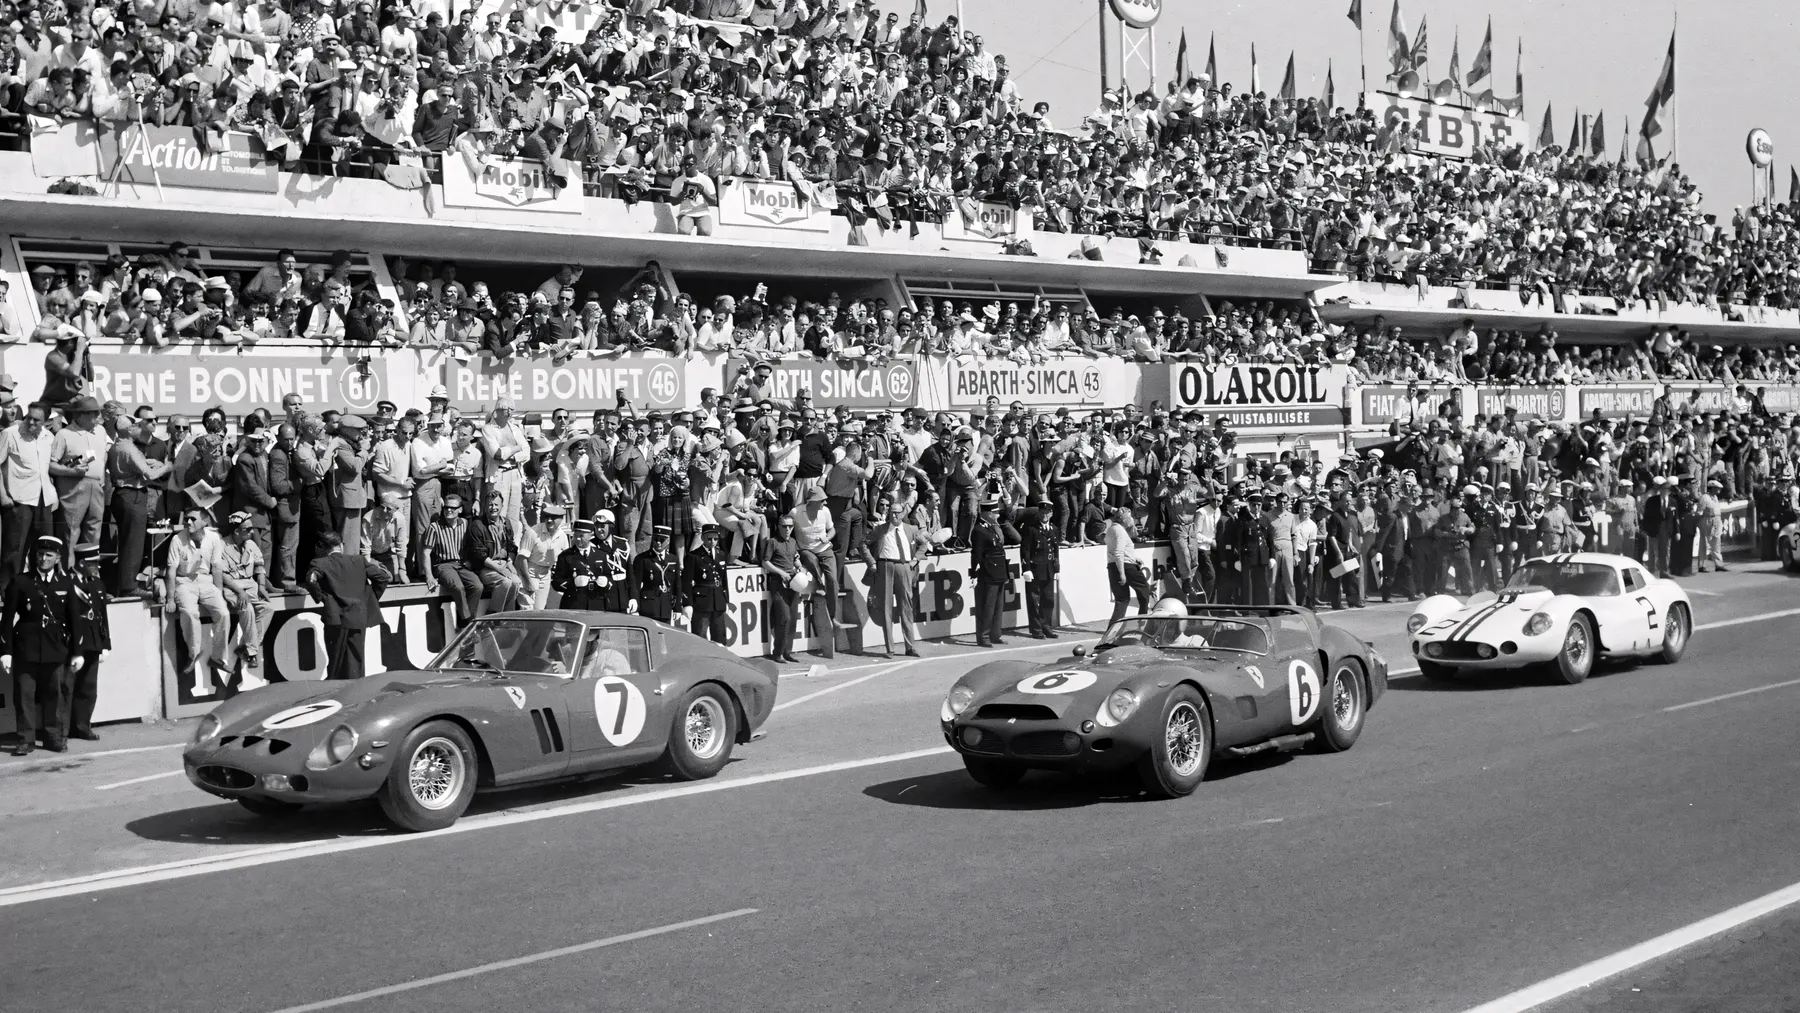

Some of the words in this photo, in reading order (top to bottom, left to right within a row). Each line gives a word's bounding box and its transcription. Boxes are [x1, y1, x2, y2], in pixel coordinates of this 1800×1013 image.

[749, 188, 799, 210] Mobi
[980, 208, 1011, 226] obil
[91, 365, 176, 404] RENÉ
[189, 366, 333, 403] BONNET
[532, 368, 643, 399] BONNET
[652, 370, 677, 396] 46
[820, 369, 884, 398] SIMCA
[890, 371, 909, 395] 62
[1083, 371, 1100, 393] 43
[1178, 365, 1327, 406] OLAROIL
[1369, 394, 1396, 417] FIAT
[1484, 395, 1506, 415] FIAT
[1635, 596, 1658, 630] 2
[1033, 672, 1080, 690] 6
[1296, 665, 1312, 718] 6
[271, 704, 335, 725] 7
[603, 682, 629, 736] 7
